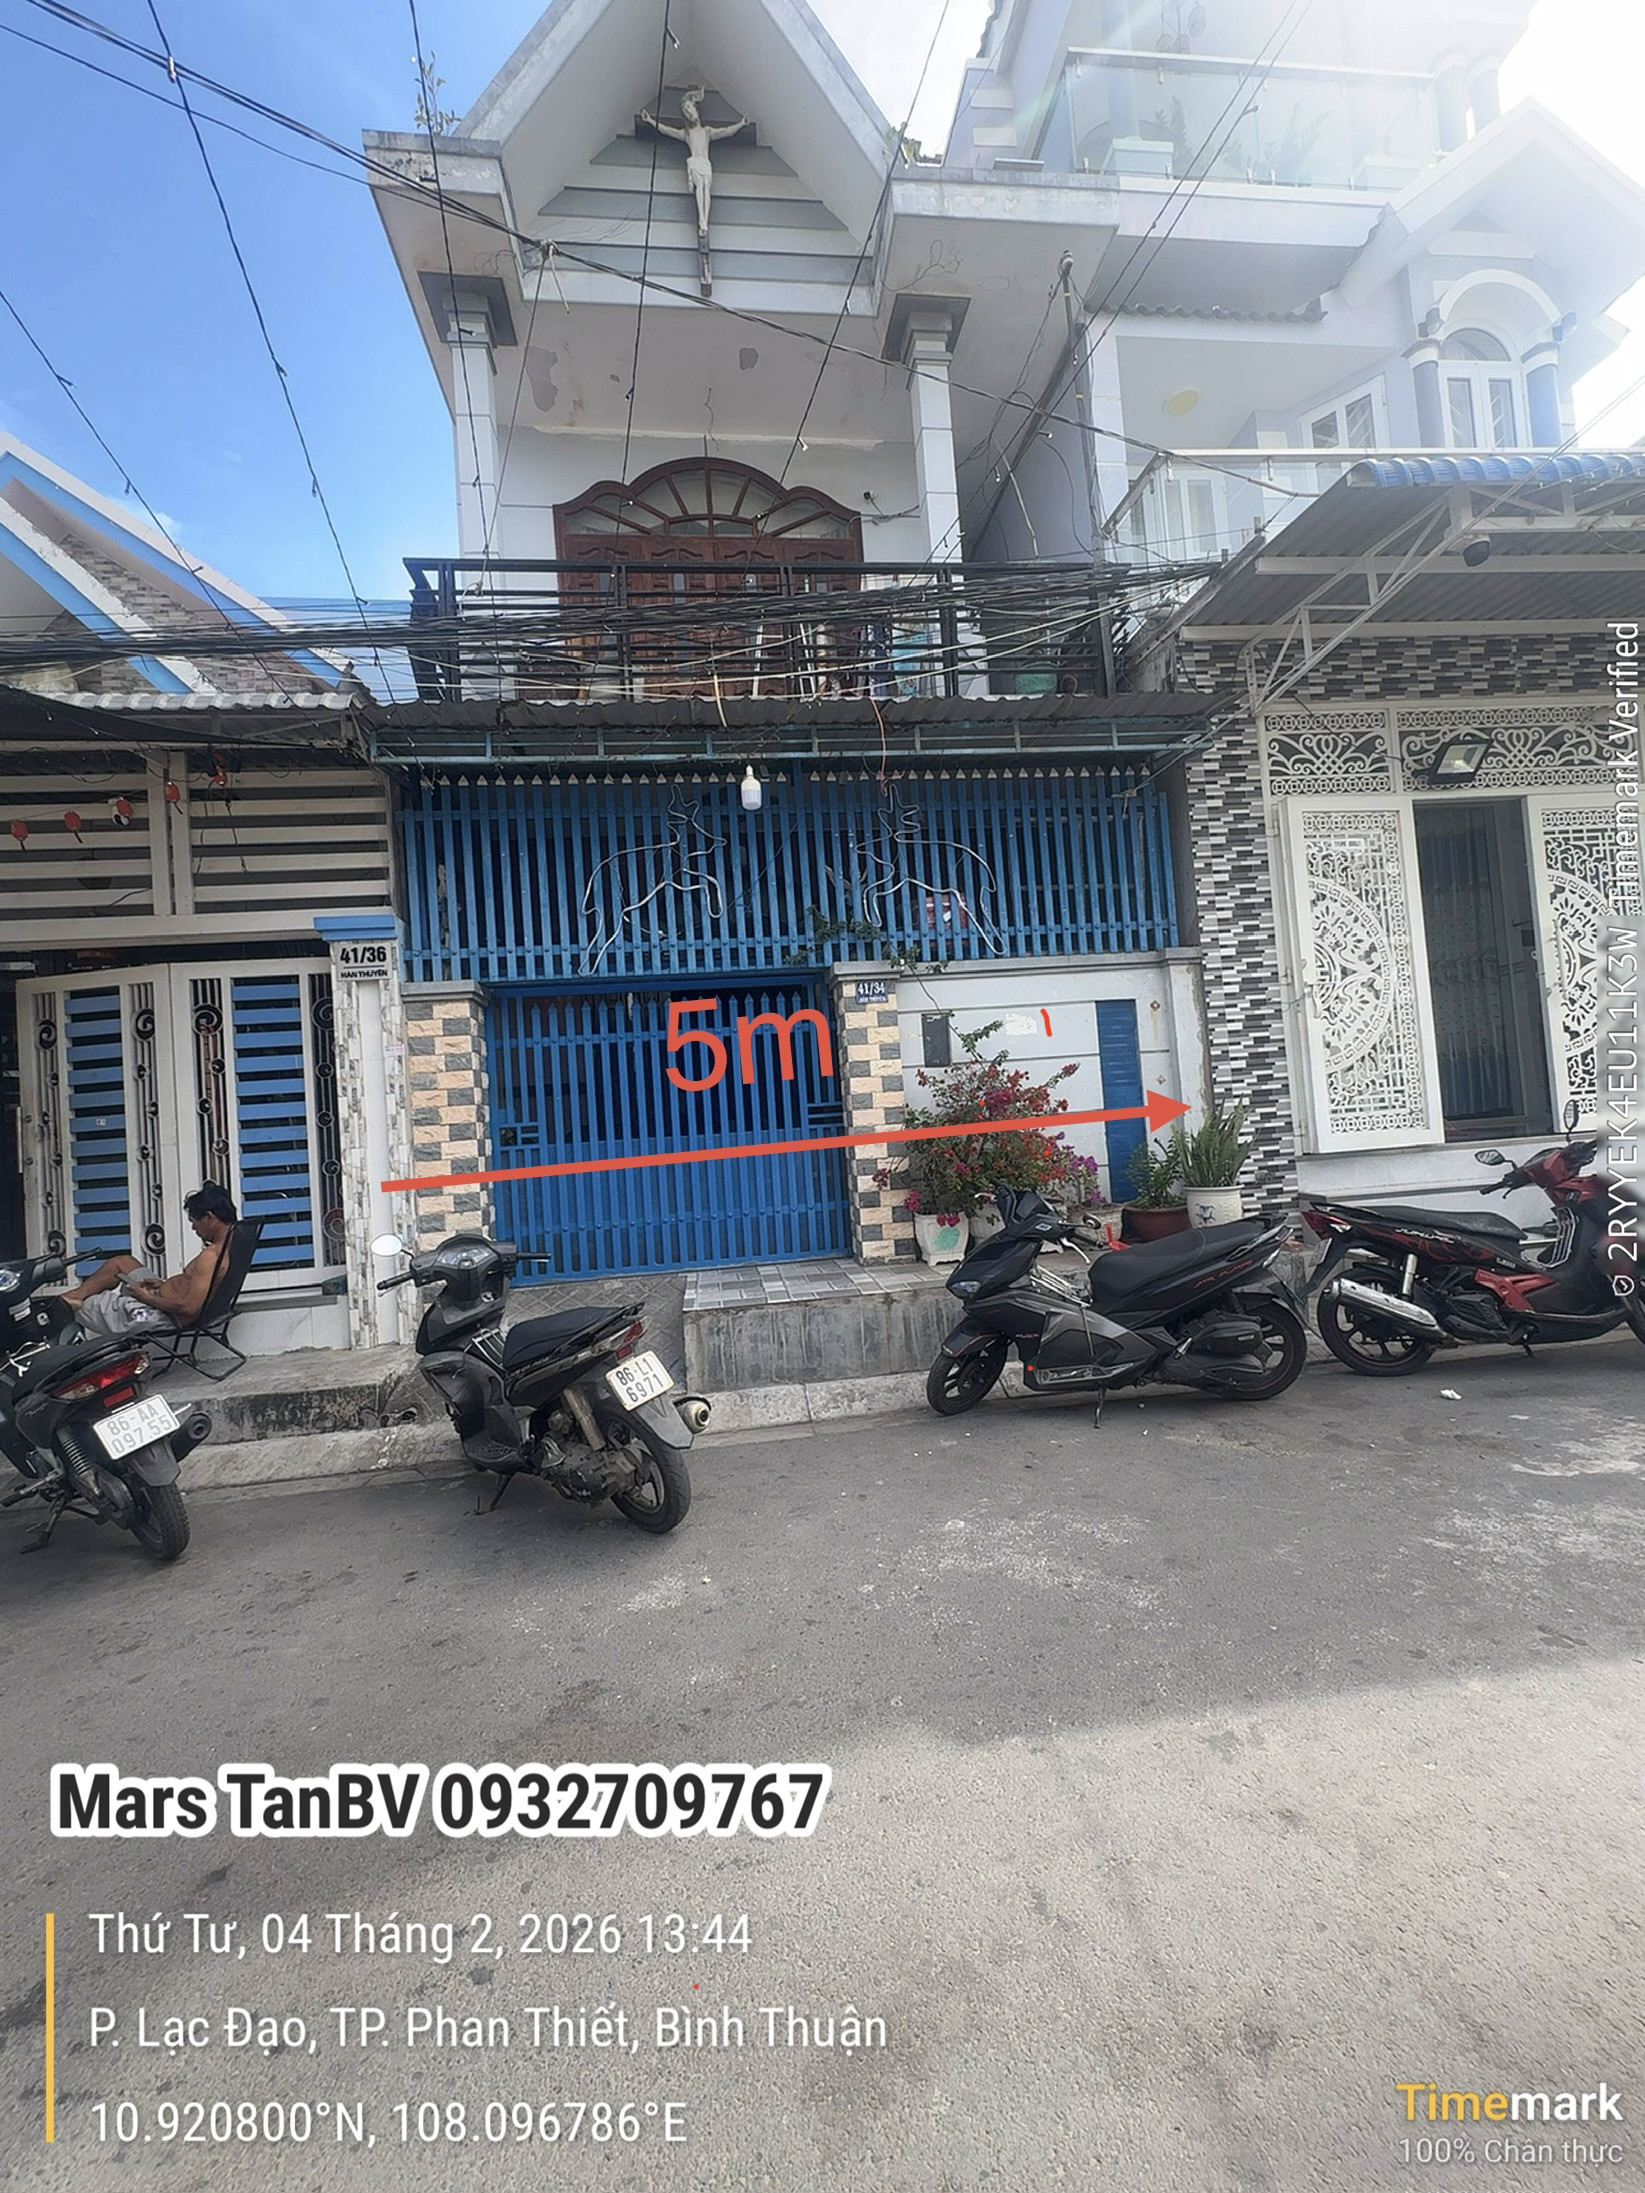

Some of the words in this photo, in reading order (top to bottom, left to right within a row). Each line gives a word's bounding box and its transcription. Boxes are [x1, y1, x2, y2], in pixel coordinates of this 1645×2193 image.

[340, 946, 387, 964] 41/36
[858, 981, 886, 996] 41/34
[615, 1358, 654, 1386] 86-L1
[625, 1373, 664, 1402] 6971
[107, 1403, 159, 1436] 86-AA
